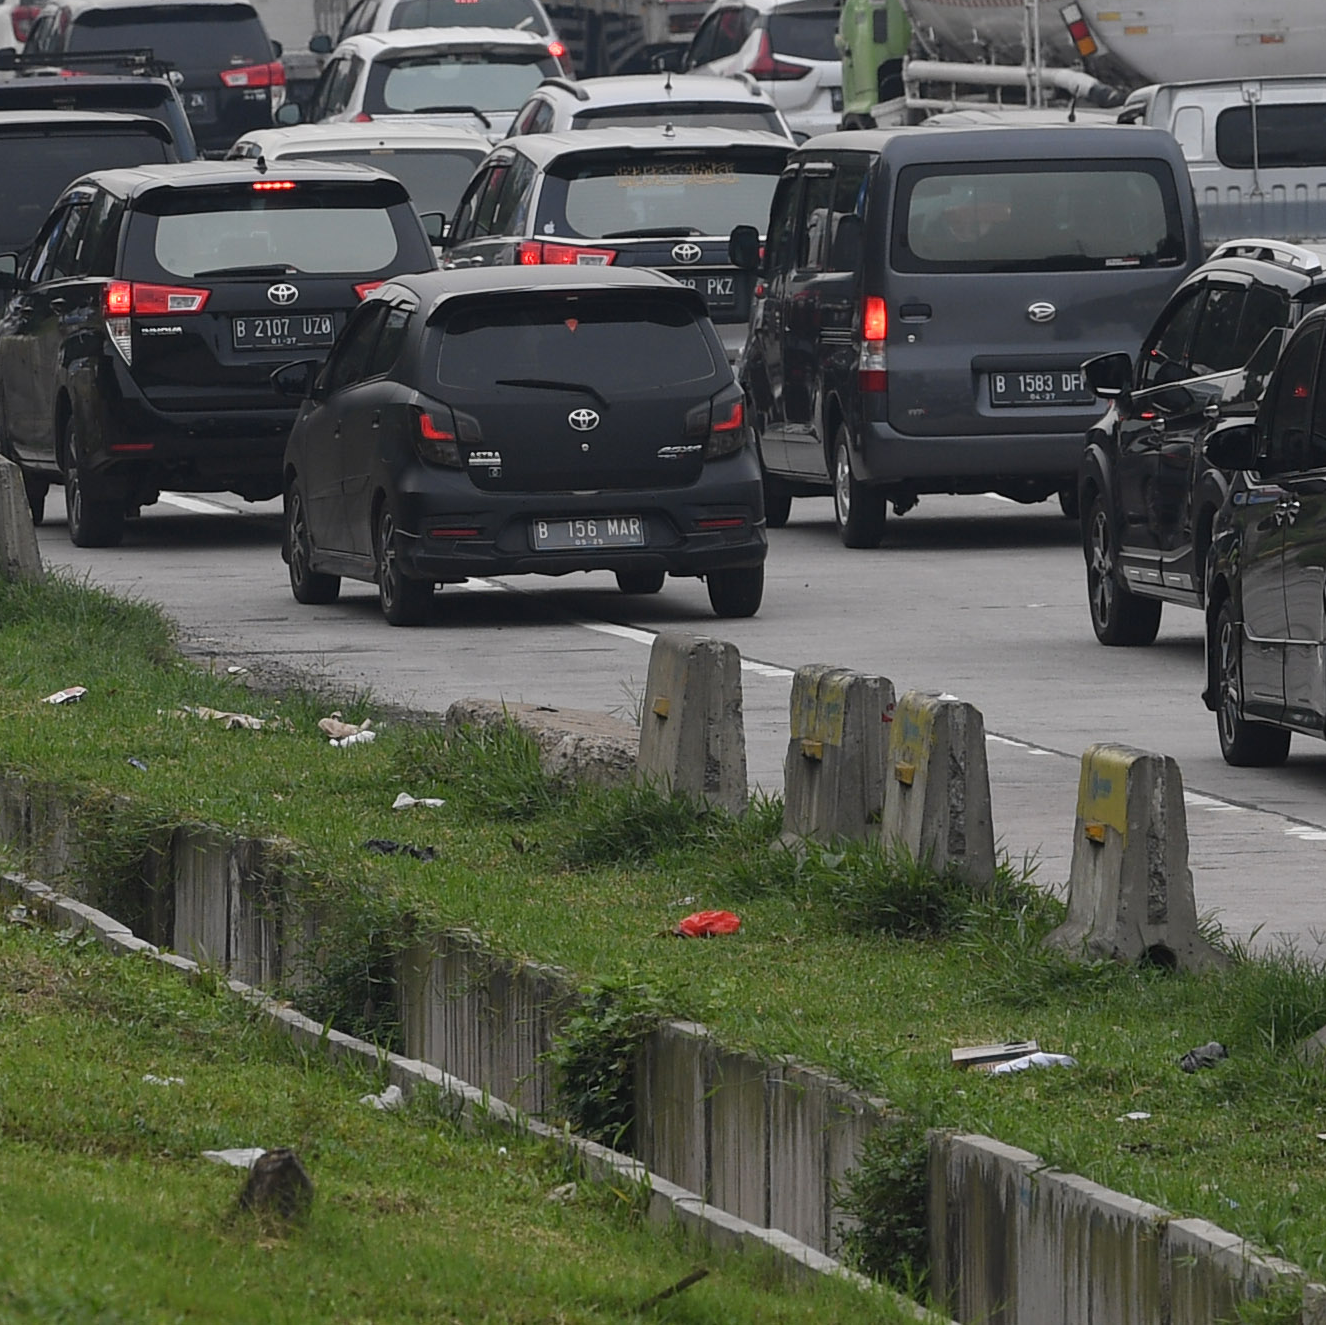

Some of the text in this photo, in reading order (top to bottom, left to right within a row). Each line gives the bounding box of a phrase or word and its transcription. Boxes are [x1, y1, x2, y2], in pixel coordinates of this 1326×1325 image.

[707, 278, 735, 295] PKZ
[236, 320, 246, 338] B
[254, 318, 290, 337] 2107
[996, 375, 1006, 393] B
[1018, 374, 1053, 393] 1583
[538, 517, 641, 539] B 156 MAR
